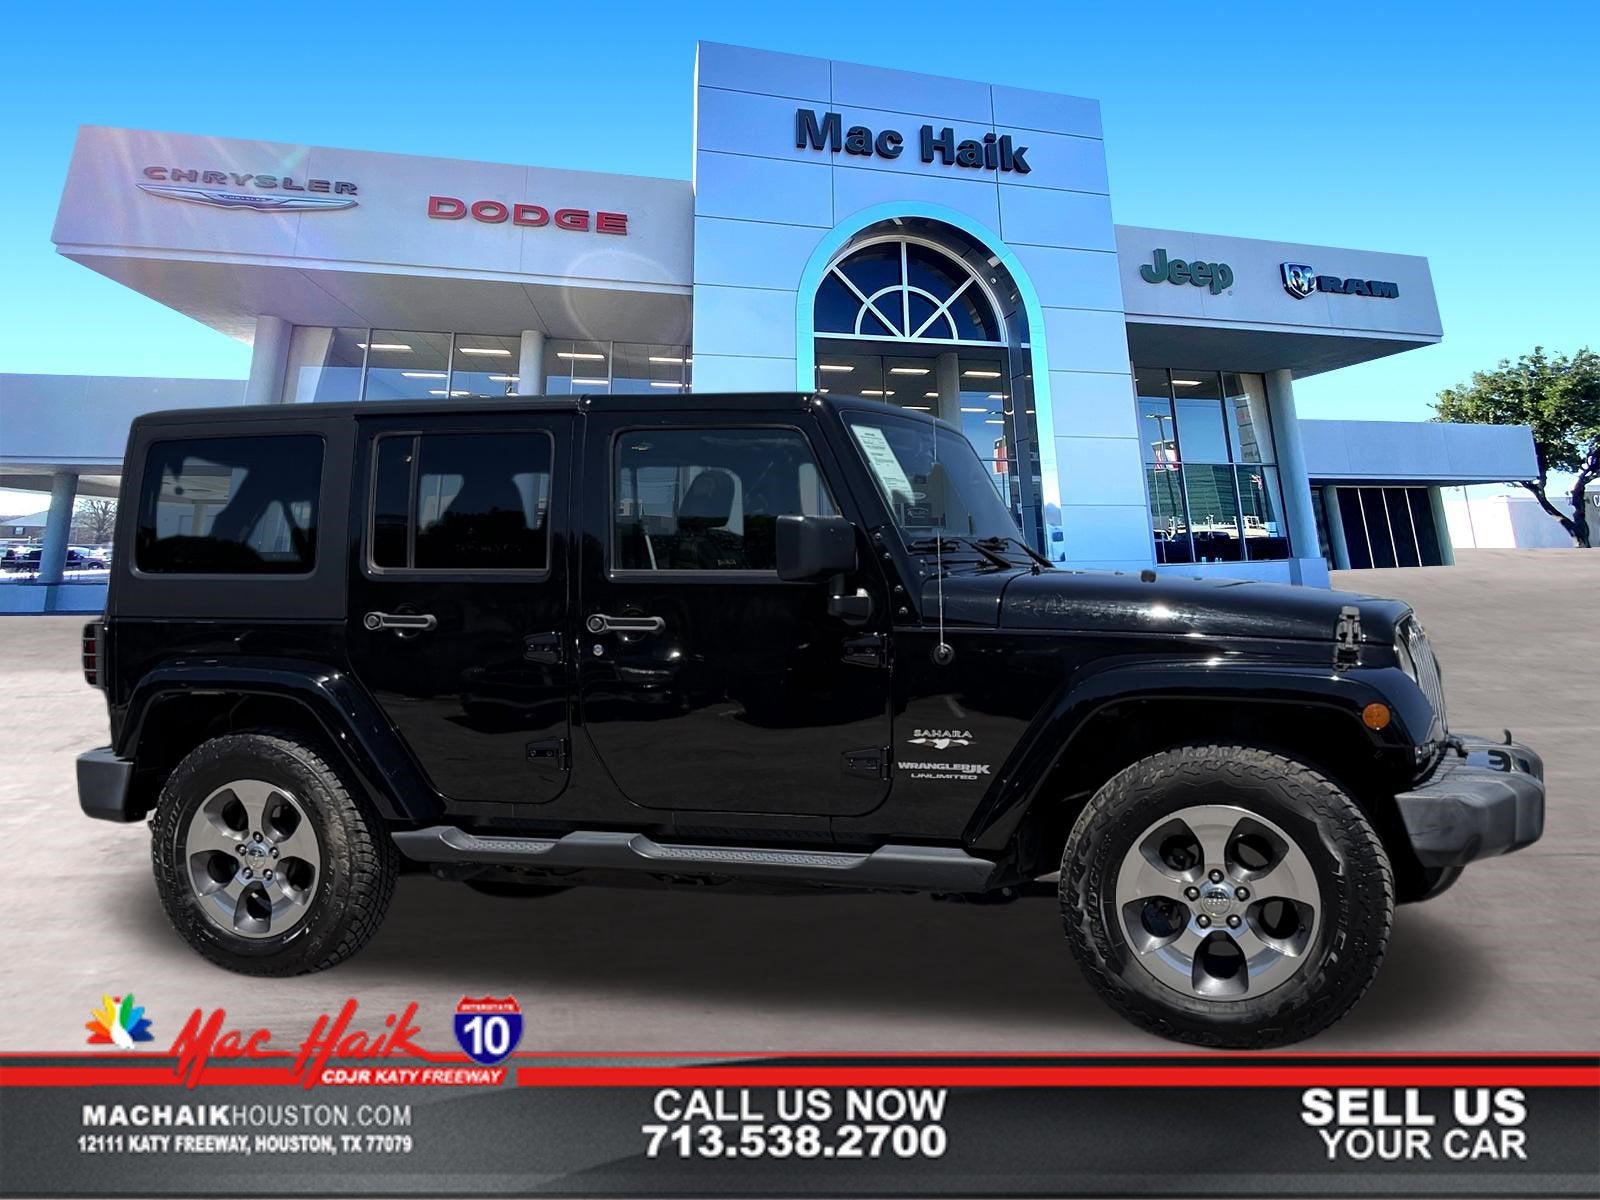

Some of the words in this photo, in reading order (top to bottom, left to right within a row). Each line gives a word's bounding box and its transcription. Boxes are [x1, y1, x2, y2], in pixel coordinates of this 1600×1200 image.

[795, 108, 904, 160] Mac
[920, 124, 1032, 175] Haik
[143, 166, 358, 196] CHRYSLER
[428, 195, 629, 236] DODGE
[1140, 248, 1234, 296] Jeep
[1316, 275, 1400, 299] RAM
[913, 729, 973, 738] SAHARA
